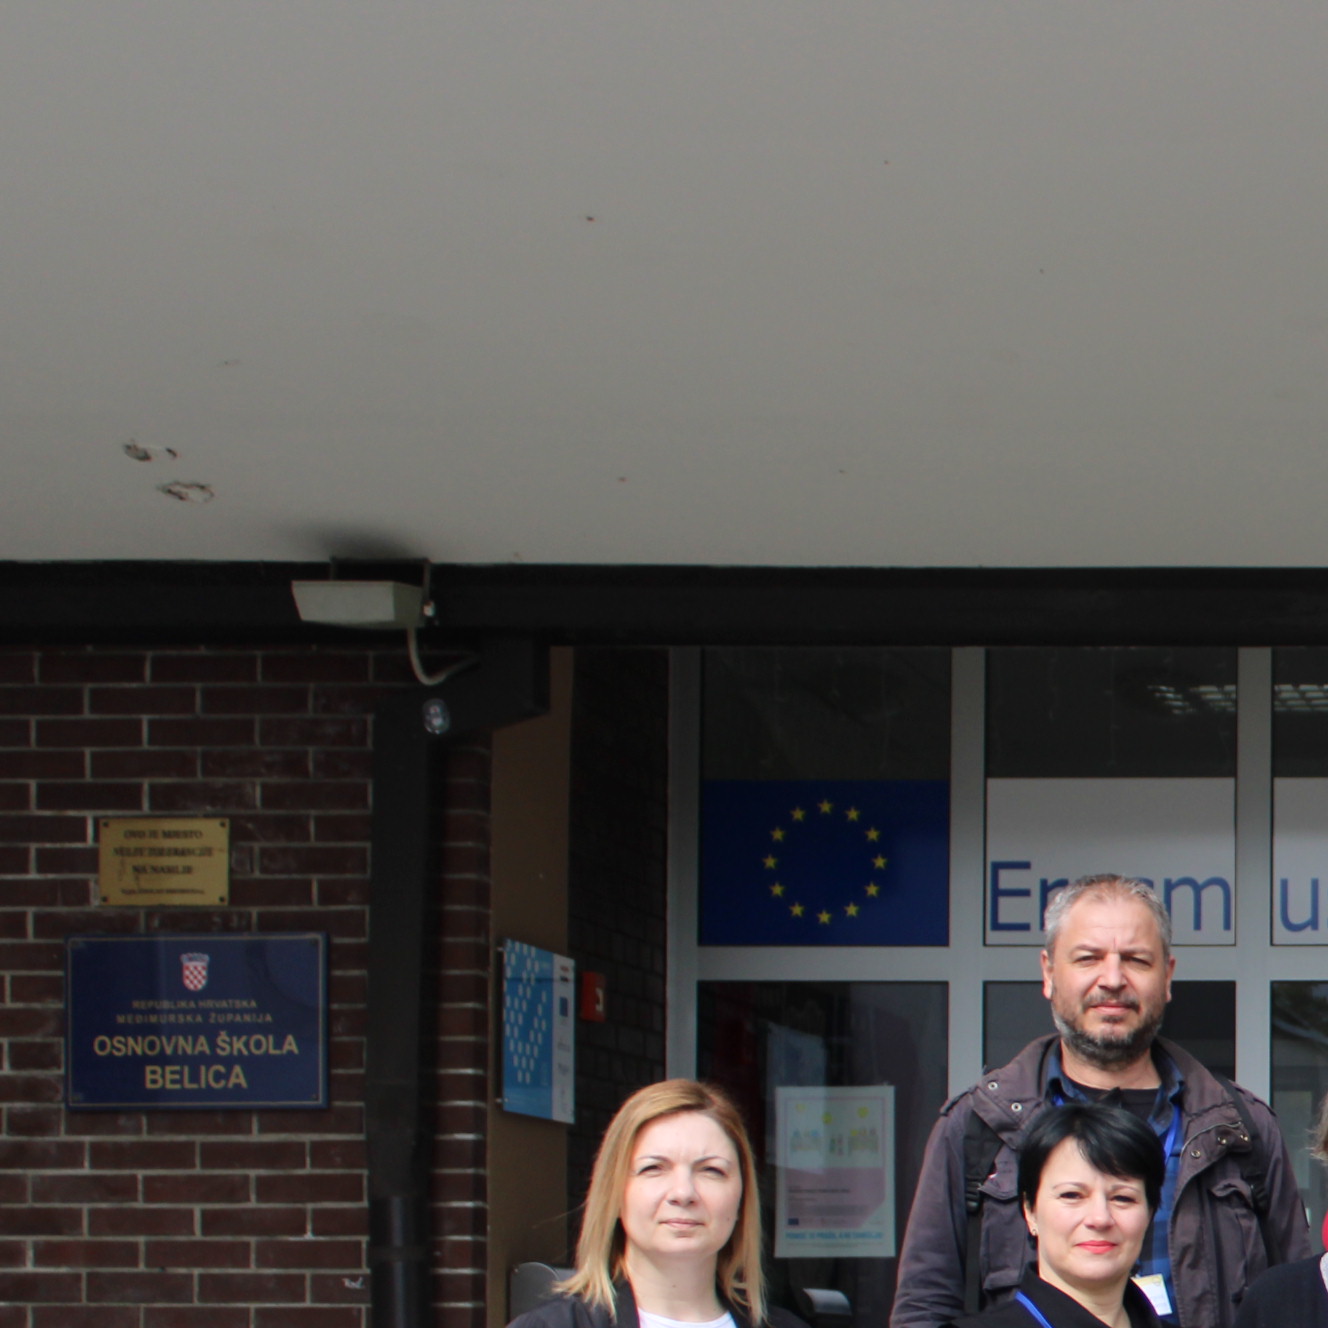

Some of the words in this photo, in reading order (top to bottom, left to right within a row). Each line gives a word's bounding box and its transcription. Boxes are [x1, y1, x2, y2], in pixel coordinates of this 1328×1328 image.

[131, 1000, 196, 1010] REPUBLIKA
[197, 999, 258, 1009] HRVATSKA
[208, 1011, 273, 1024] ŽUPANIJA
[93, 1034, 210, 1056] OSNOVNA
[216, 1030, 299, 1056] ŠKOLA
[144, 1065, 248, 1090] BELICA
